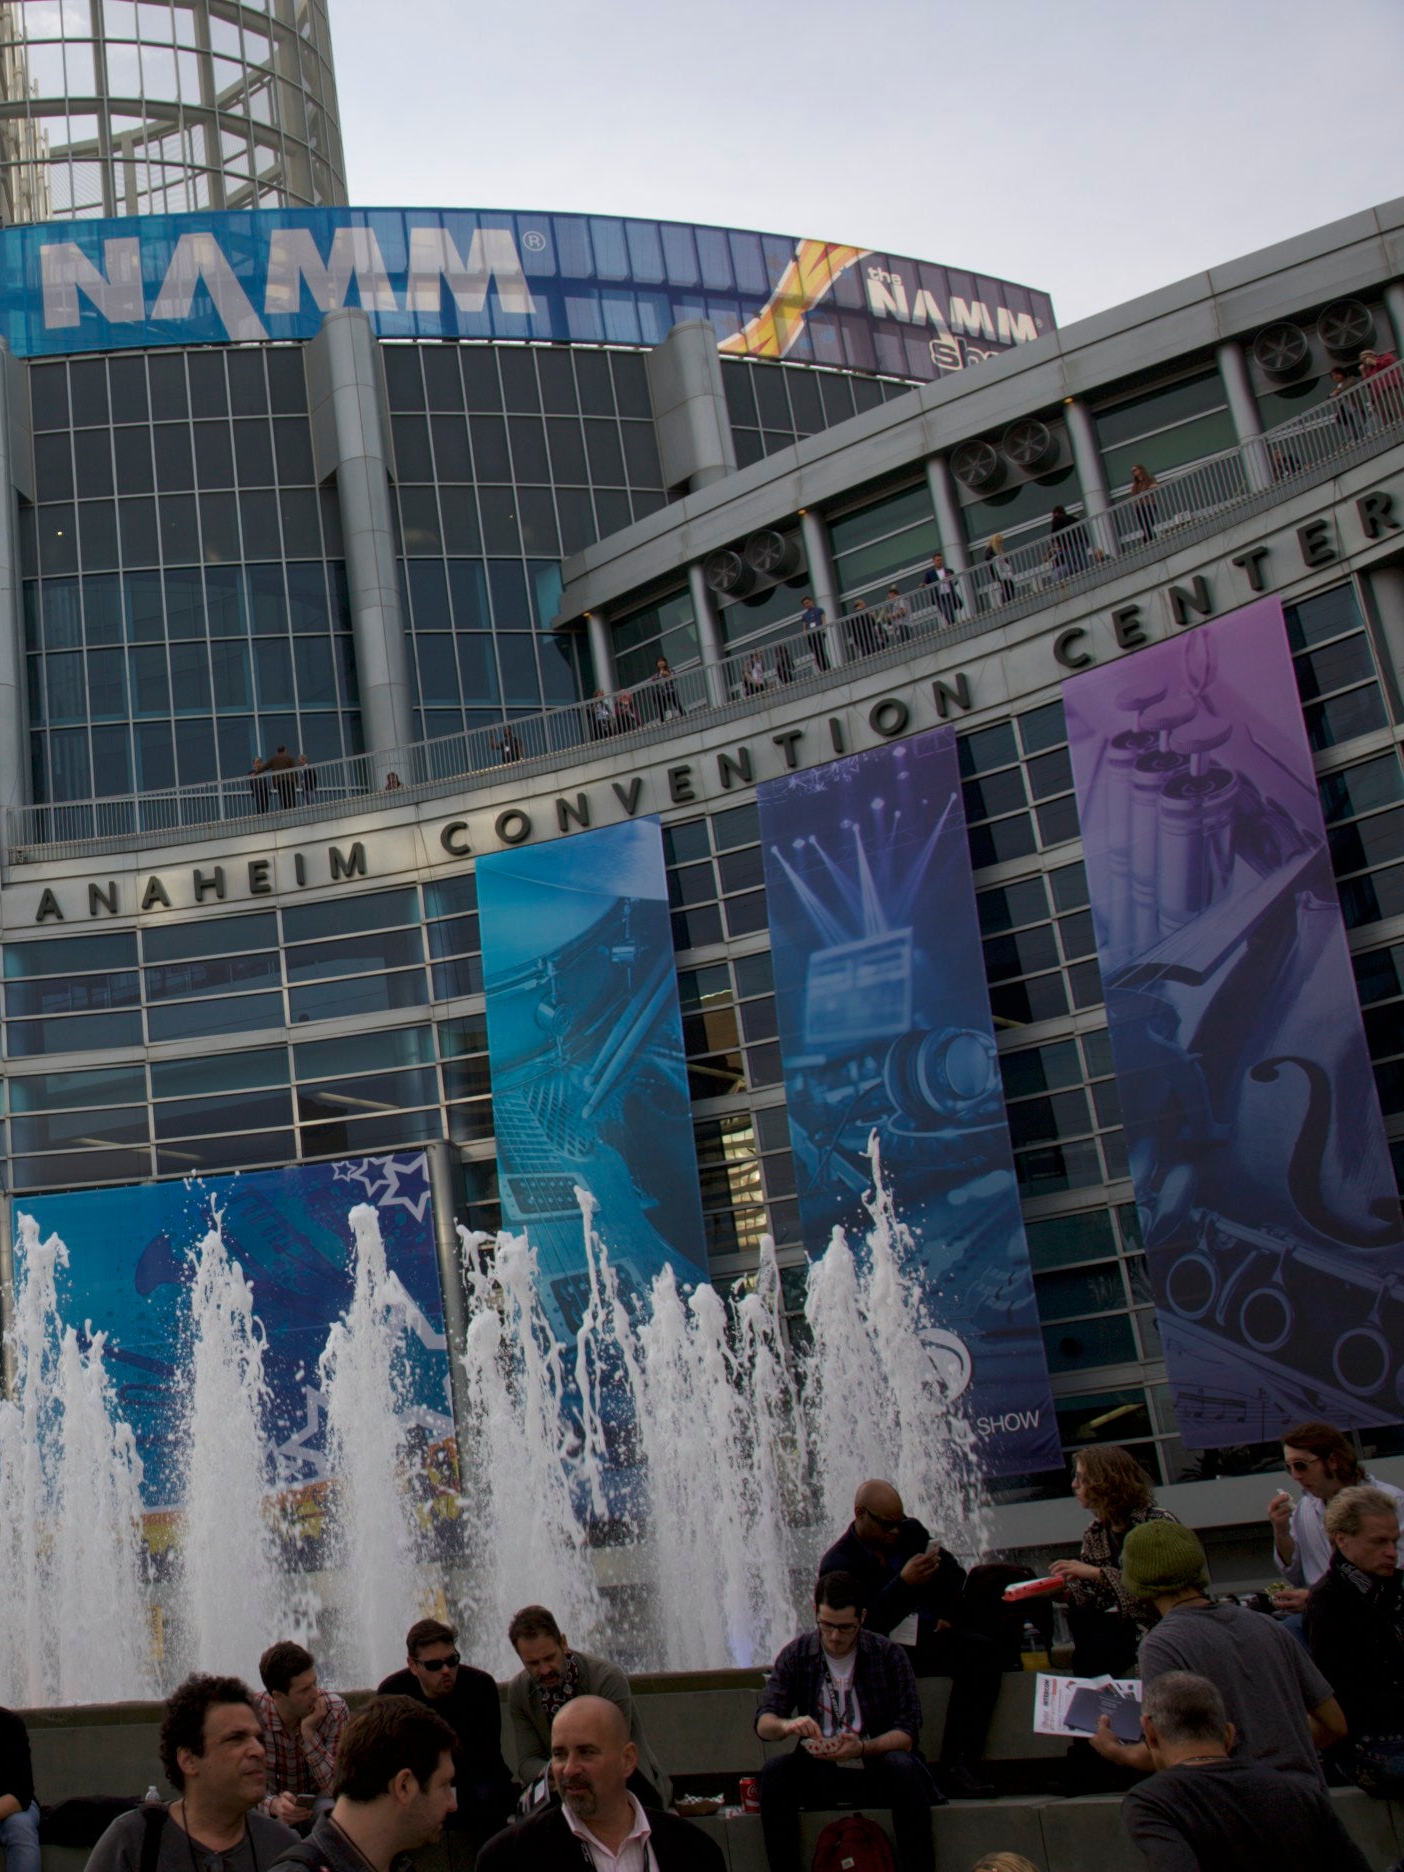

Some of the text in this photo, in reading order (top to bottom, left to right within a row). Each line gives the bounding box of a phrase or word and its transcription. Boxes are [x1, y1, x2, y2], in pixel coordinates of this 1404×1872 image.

[867, 266, 902, 286] the
[929, 336, 1000, 371] sh
[35, 490, 1402, 923] ANAHEIM CONVENTION CENTER
[976, 1409, 1040, 1436] SHOW
